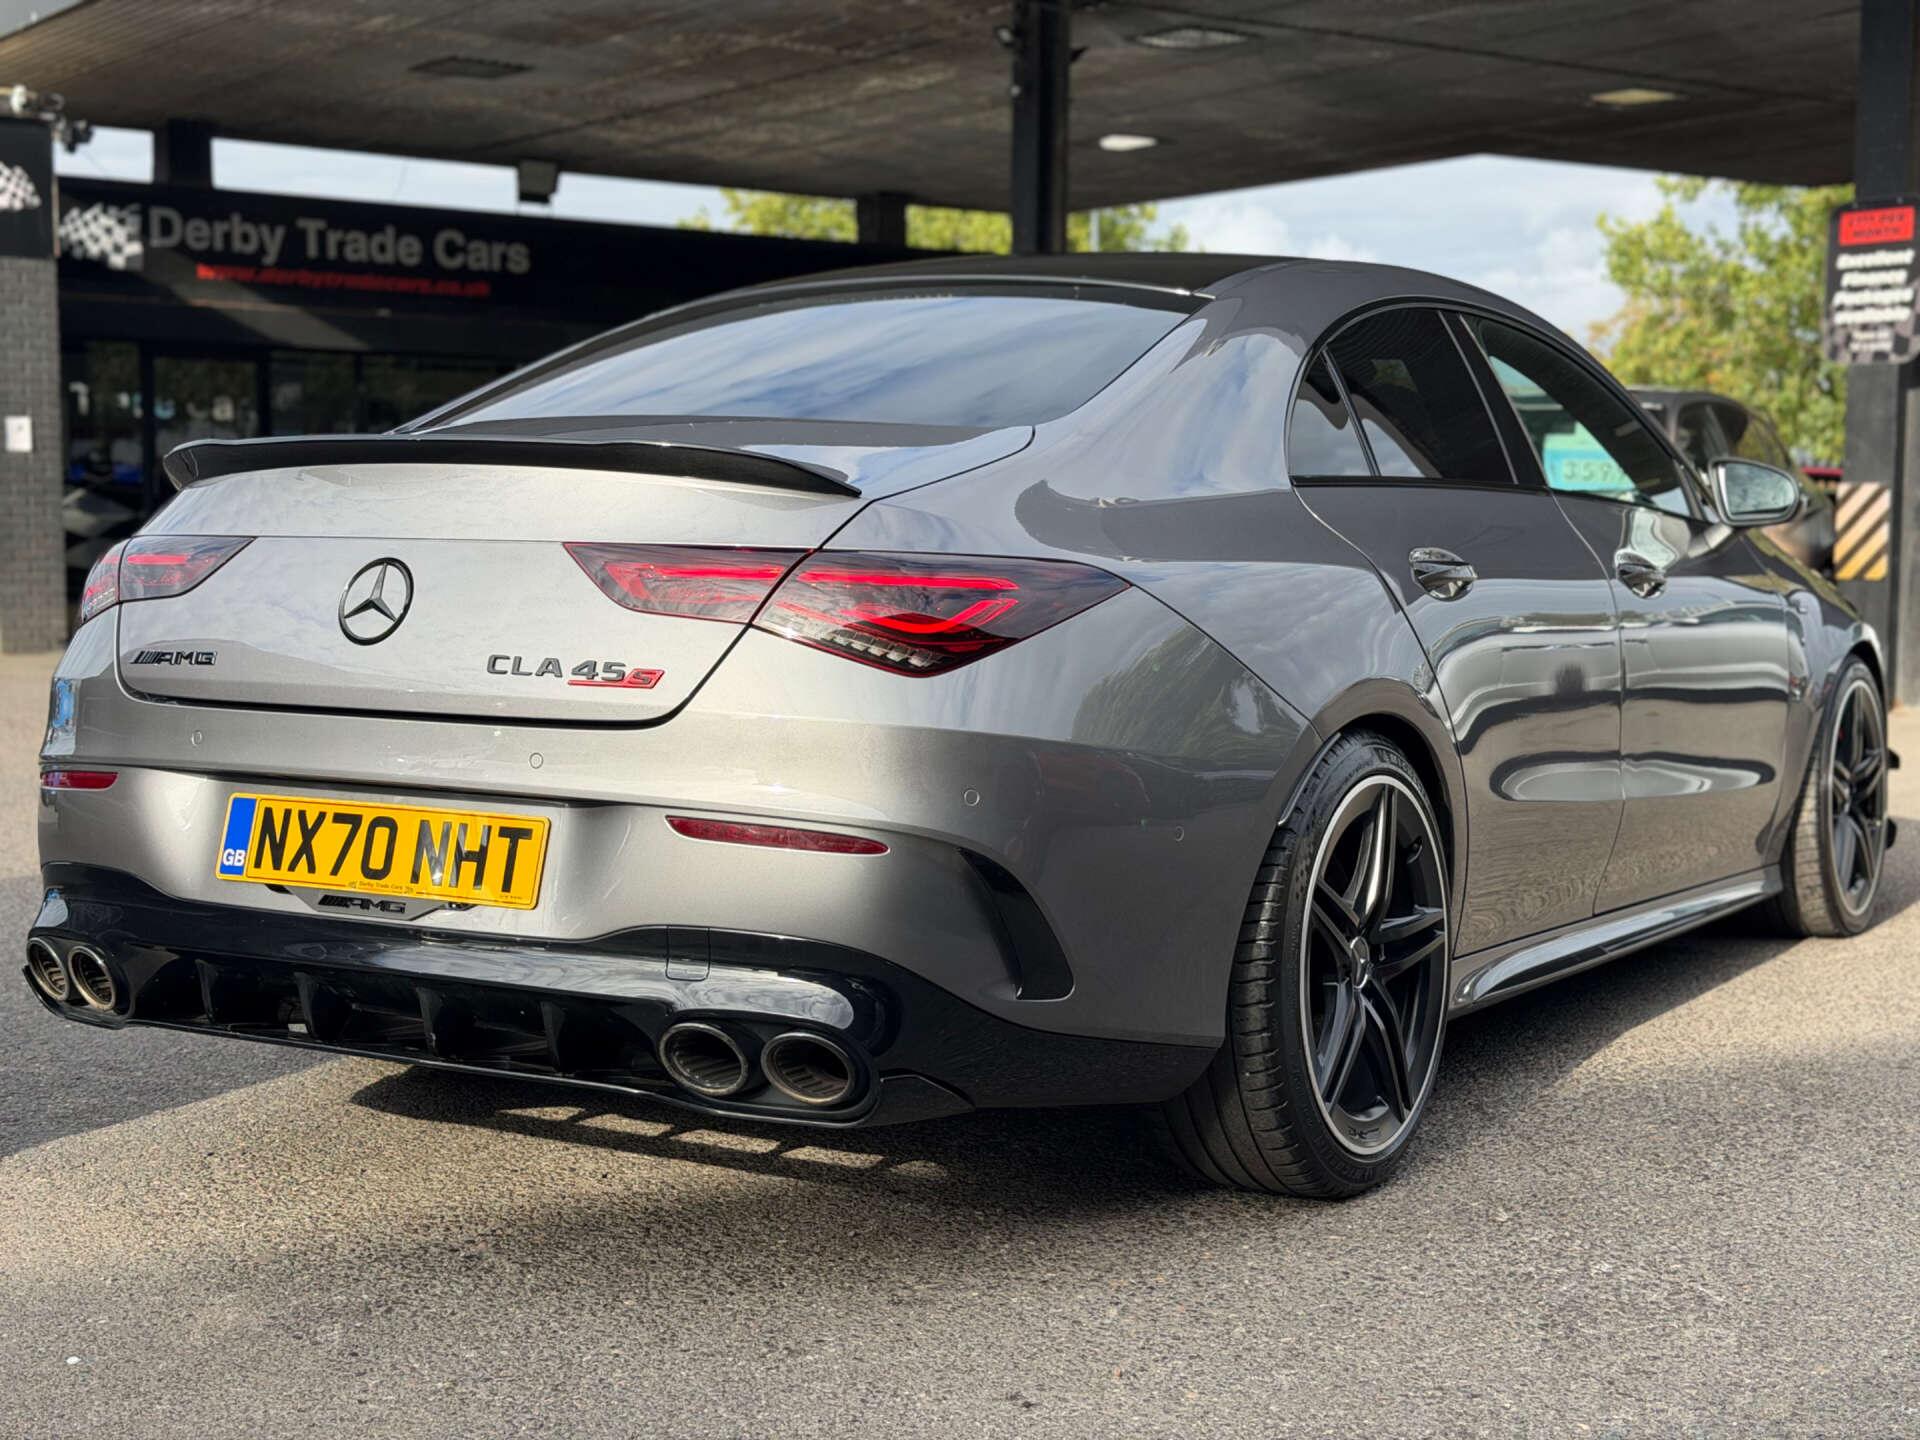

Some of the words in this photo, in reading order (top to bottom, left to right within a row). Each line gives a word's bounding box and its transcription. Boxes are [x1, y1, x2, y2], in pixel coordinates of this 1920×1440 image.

[149, 206, 285, 264] Derby
[296, 217, 423, 266] Trade
[433, 229, 531, 275] Cars
[146, 650, 218, 667] AMG
[487, 654, 563, 679] CLA
[221, 848, 245, 867] GB
[253, 806, 398, 881] NX70
[409, 819, 533, 893] NHT
[336, 896, 407, 914] AMG
